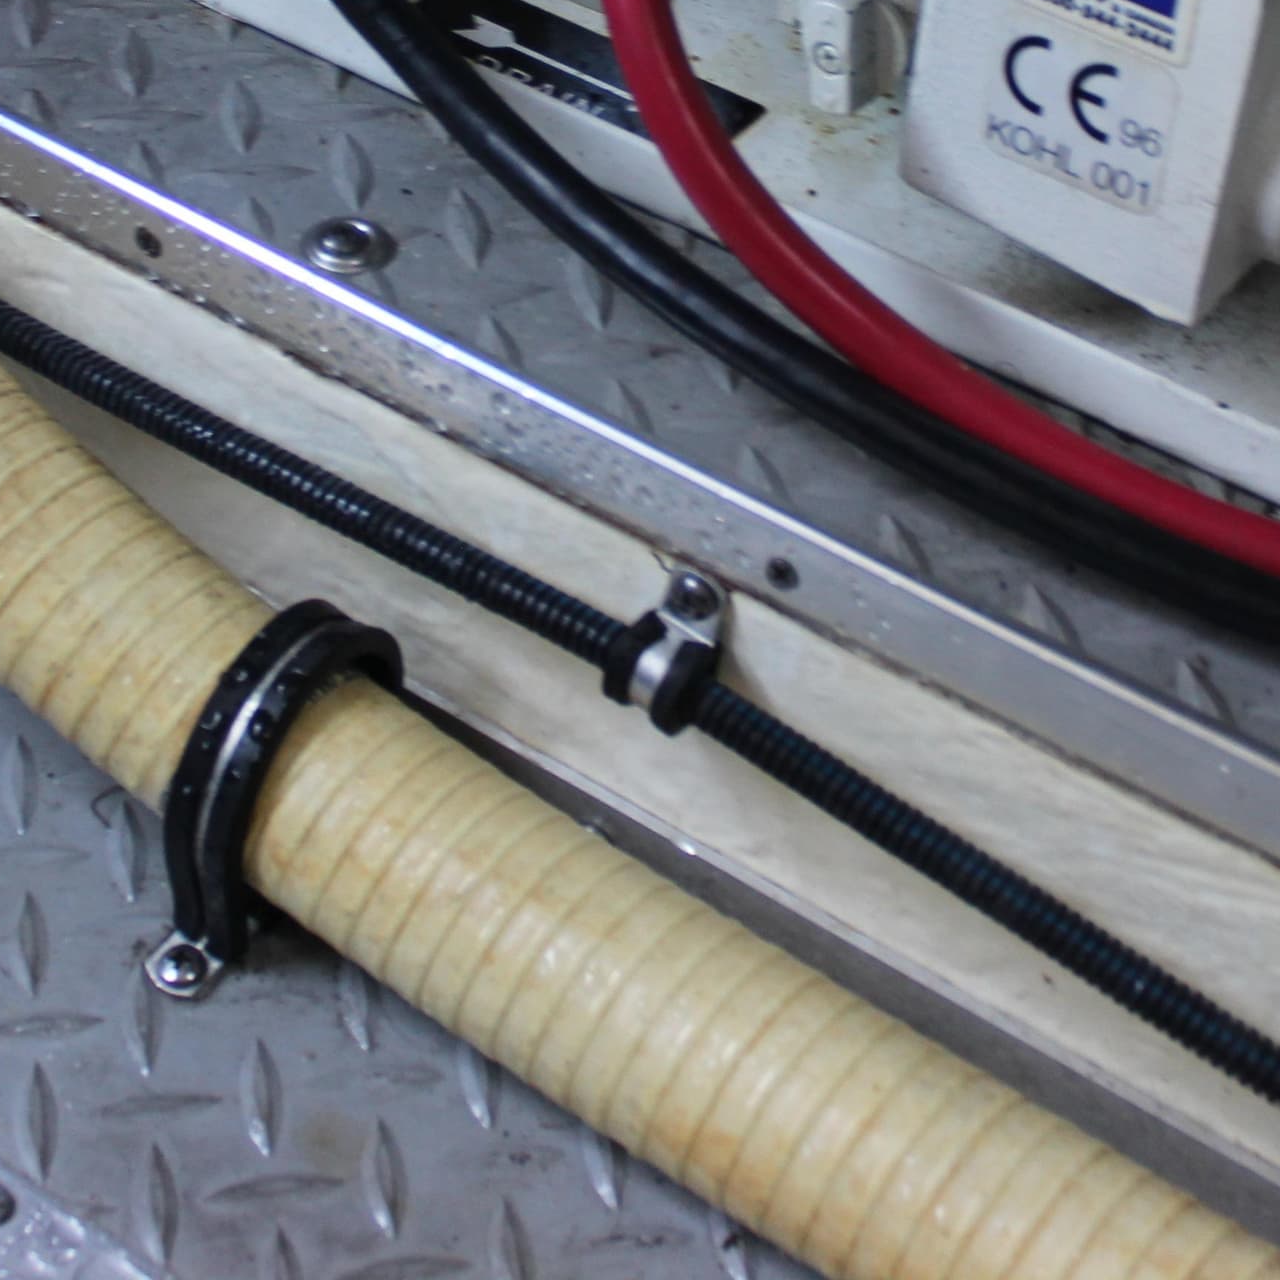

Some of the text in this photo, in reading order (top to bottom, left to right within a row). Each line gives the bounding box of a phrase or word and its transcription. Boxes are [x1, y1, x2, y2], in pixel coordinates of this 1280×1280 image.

[1003, 34, 1163, 158] CE 96
[985, 114, 1152, 207] KOHL 001
